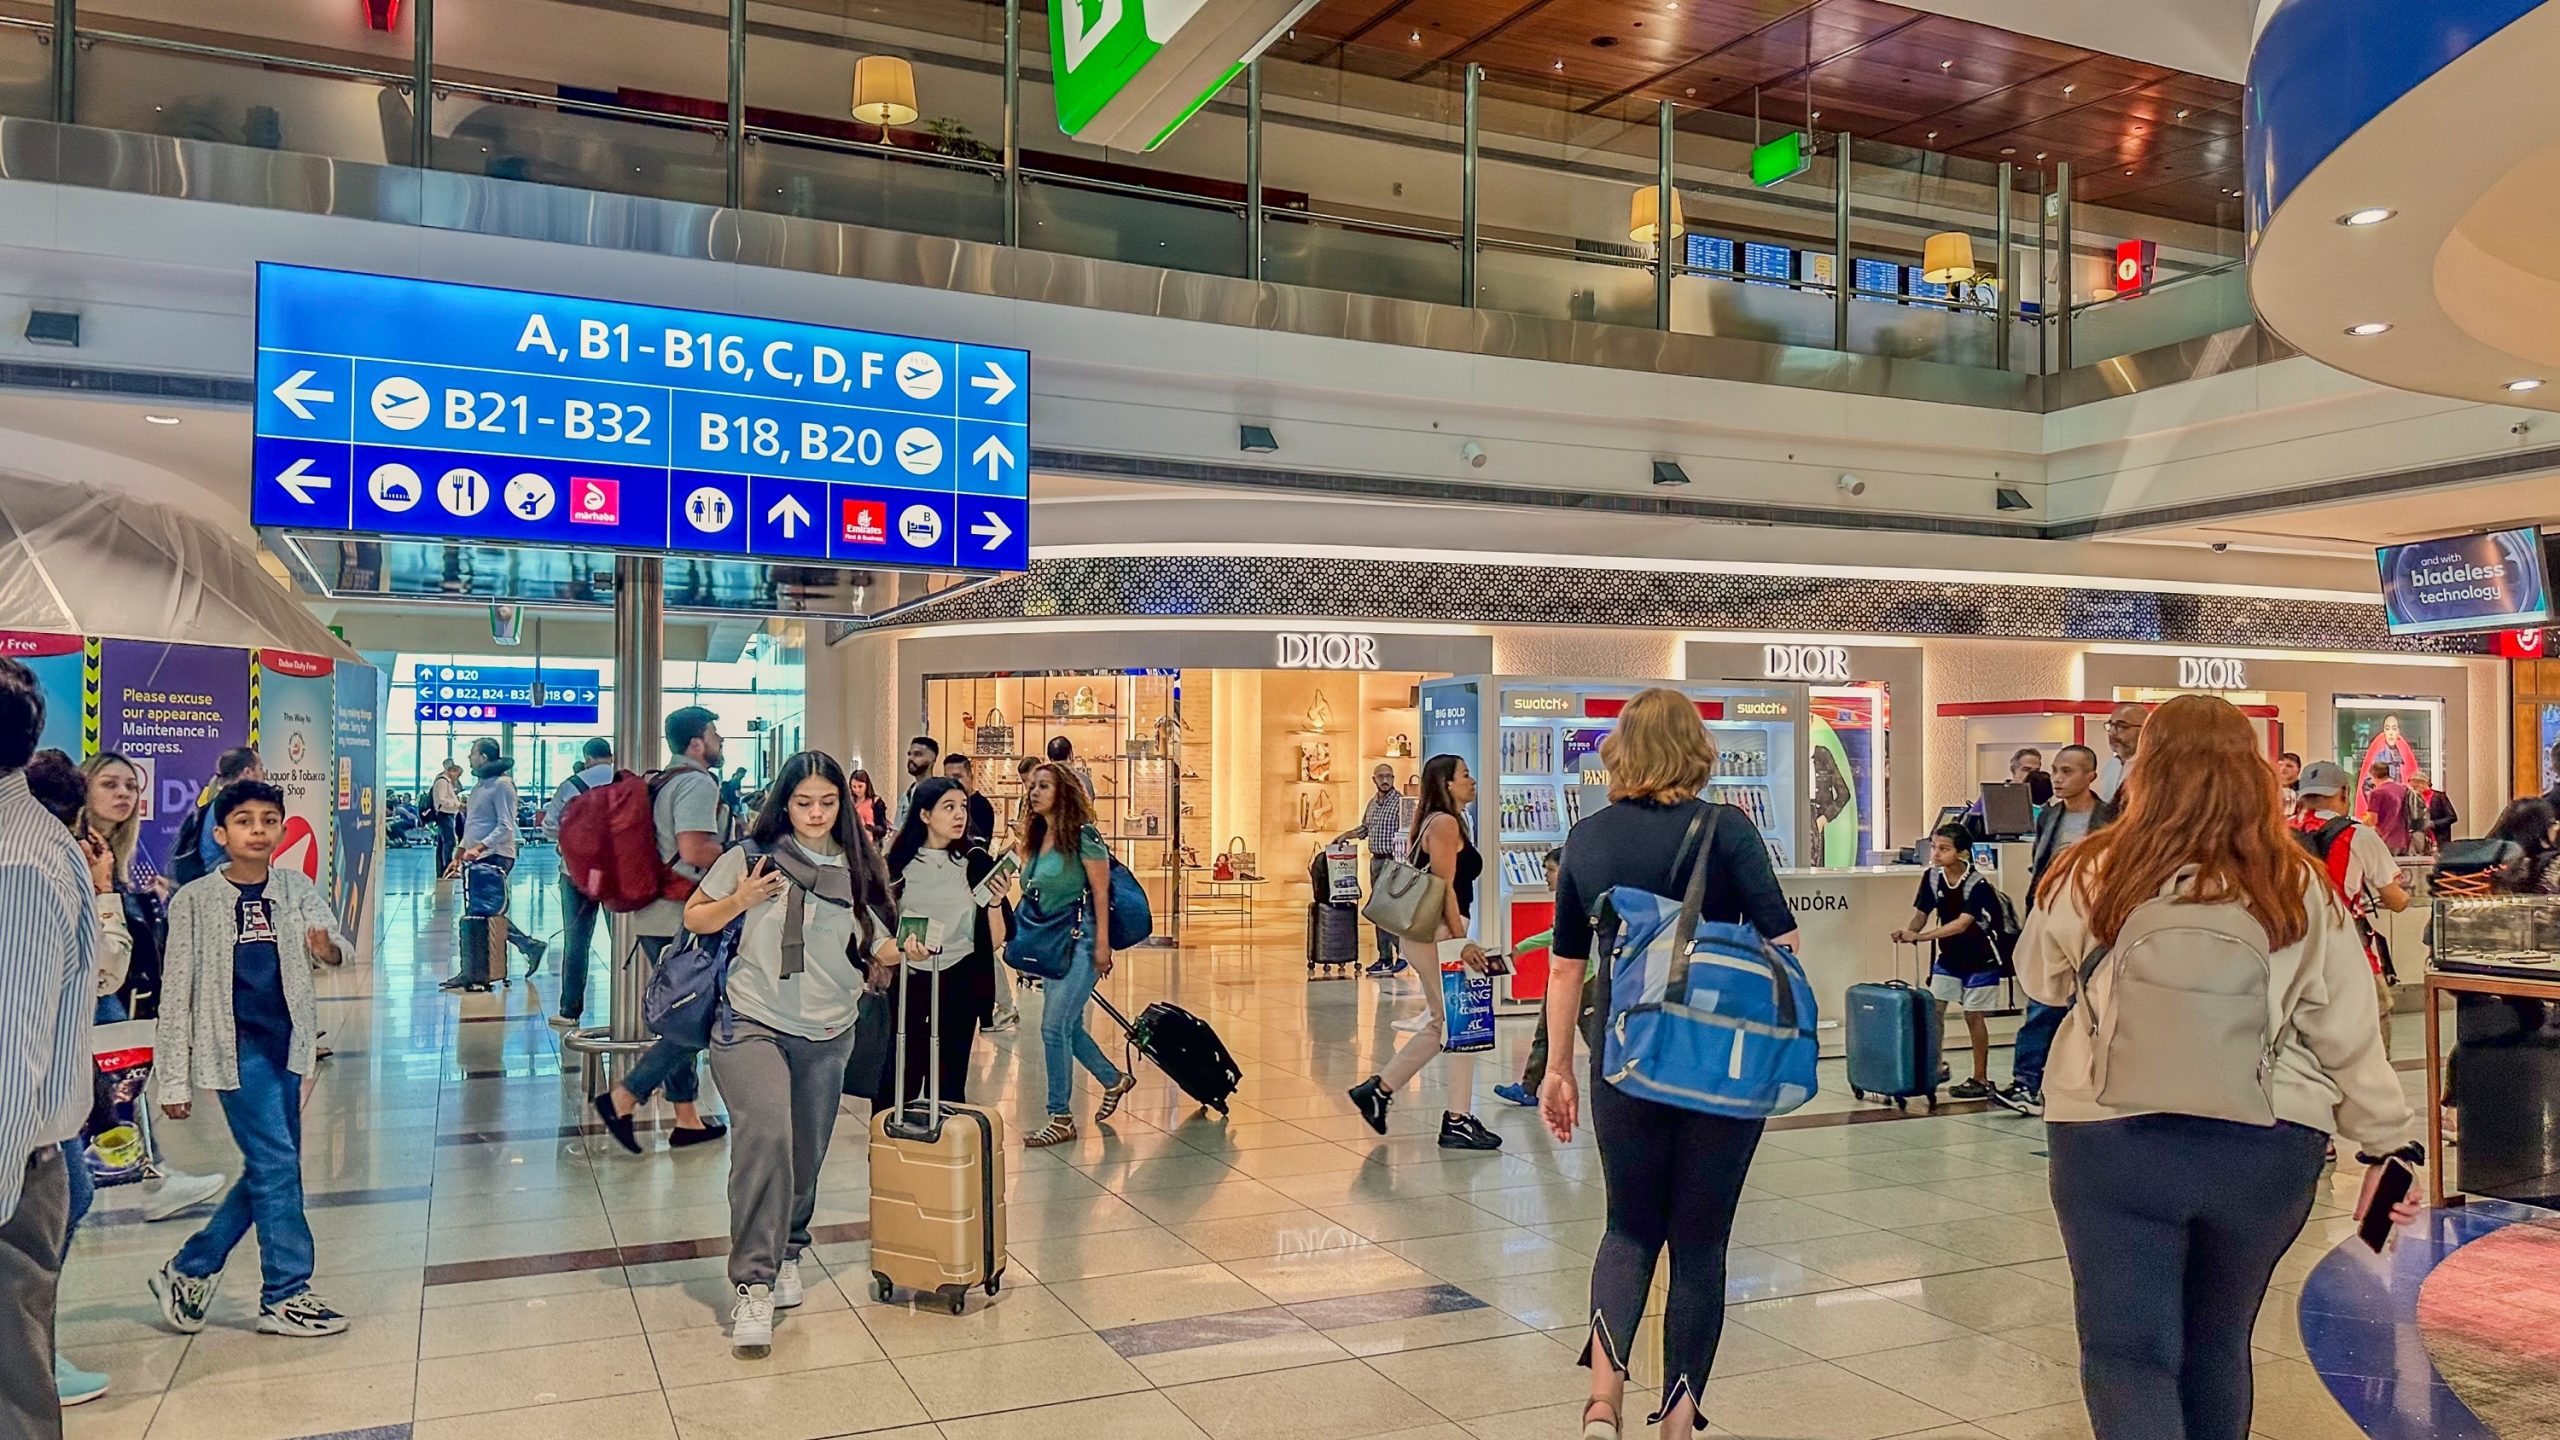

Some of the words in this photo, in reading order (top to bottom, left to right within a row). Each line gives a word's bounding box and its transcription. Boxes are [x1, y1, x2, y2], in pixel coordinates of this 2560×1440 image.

[862, 352, 884, 389] F
[700, 412, 790, 464] B18,
[801, 422, 883, 466] B20
[846, 524, 883, 535] Emirates
[2421, 555, 2439, 566] and
[2440, 553, 2461, 564] with
[2411, 563, 2505, 587] bladeless
[2419, 585, 2501, 604] technology
[7, 639, 37, 651] Free
[1277, 633, 1380, 670] DIOR
[1763, 644, 1850, 680] DIOR
[456, 670, 478, 681] B20
[2178, 656, 2248, 690] DIOR
[123, 688, 166, 703] Please
[169, 693, 213, 705] excuse
[456, 688, 481, 700] B22,
[1514, 697, 1562, 710] swatch
[1737, 702, 1780, 714] swatch
[122, 707, 144, 719] our
[147, 708, 223, 722] appearance.
[1435, 708, 1446, 719] BIG
[1447, 707, 1465, 718] BOLD
[122, 722, 205, 737] Maintenance
[207, 725, 219, 738] in
[122, 741, 183, 756] progress.
[291, 769, 297, 781] &
[299, 769, 326, 782] Tobacco
[287, 783, 305, 799] Shop
[1788, 895, 1849, 912] NDORA
[97, 1056, 120, 1067] ree
